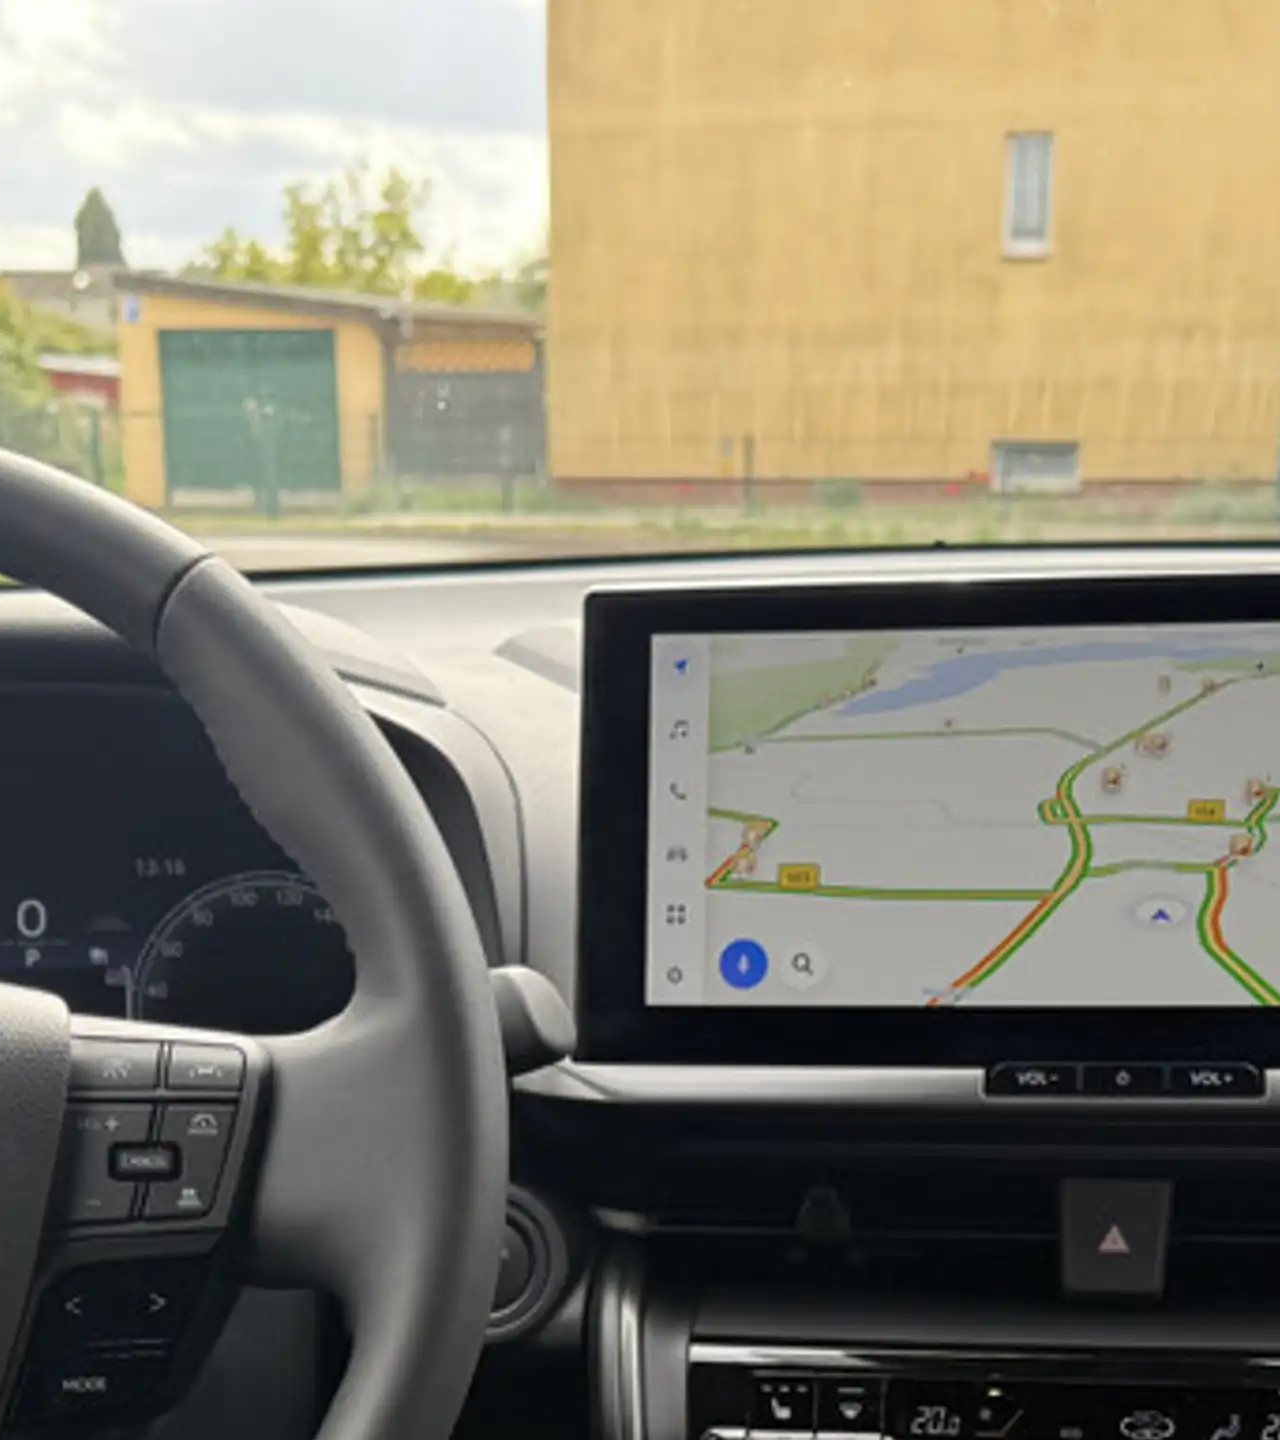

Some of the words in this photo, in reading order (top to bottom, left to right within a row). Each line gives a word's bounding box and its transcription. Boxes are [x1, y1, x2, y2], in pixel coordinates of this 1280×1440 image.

[16, 898, 48, 939] 0
[62, 1376, 108, 1393] MODE
[910, 1405, 962, 1436] 20.0
